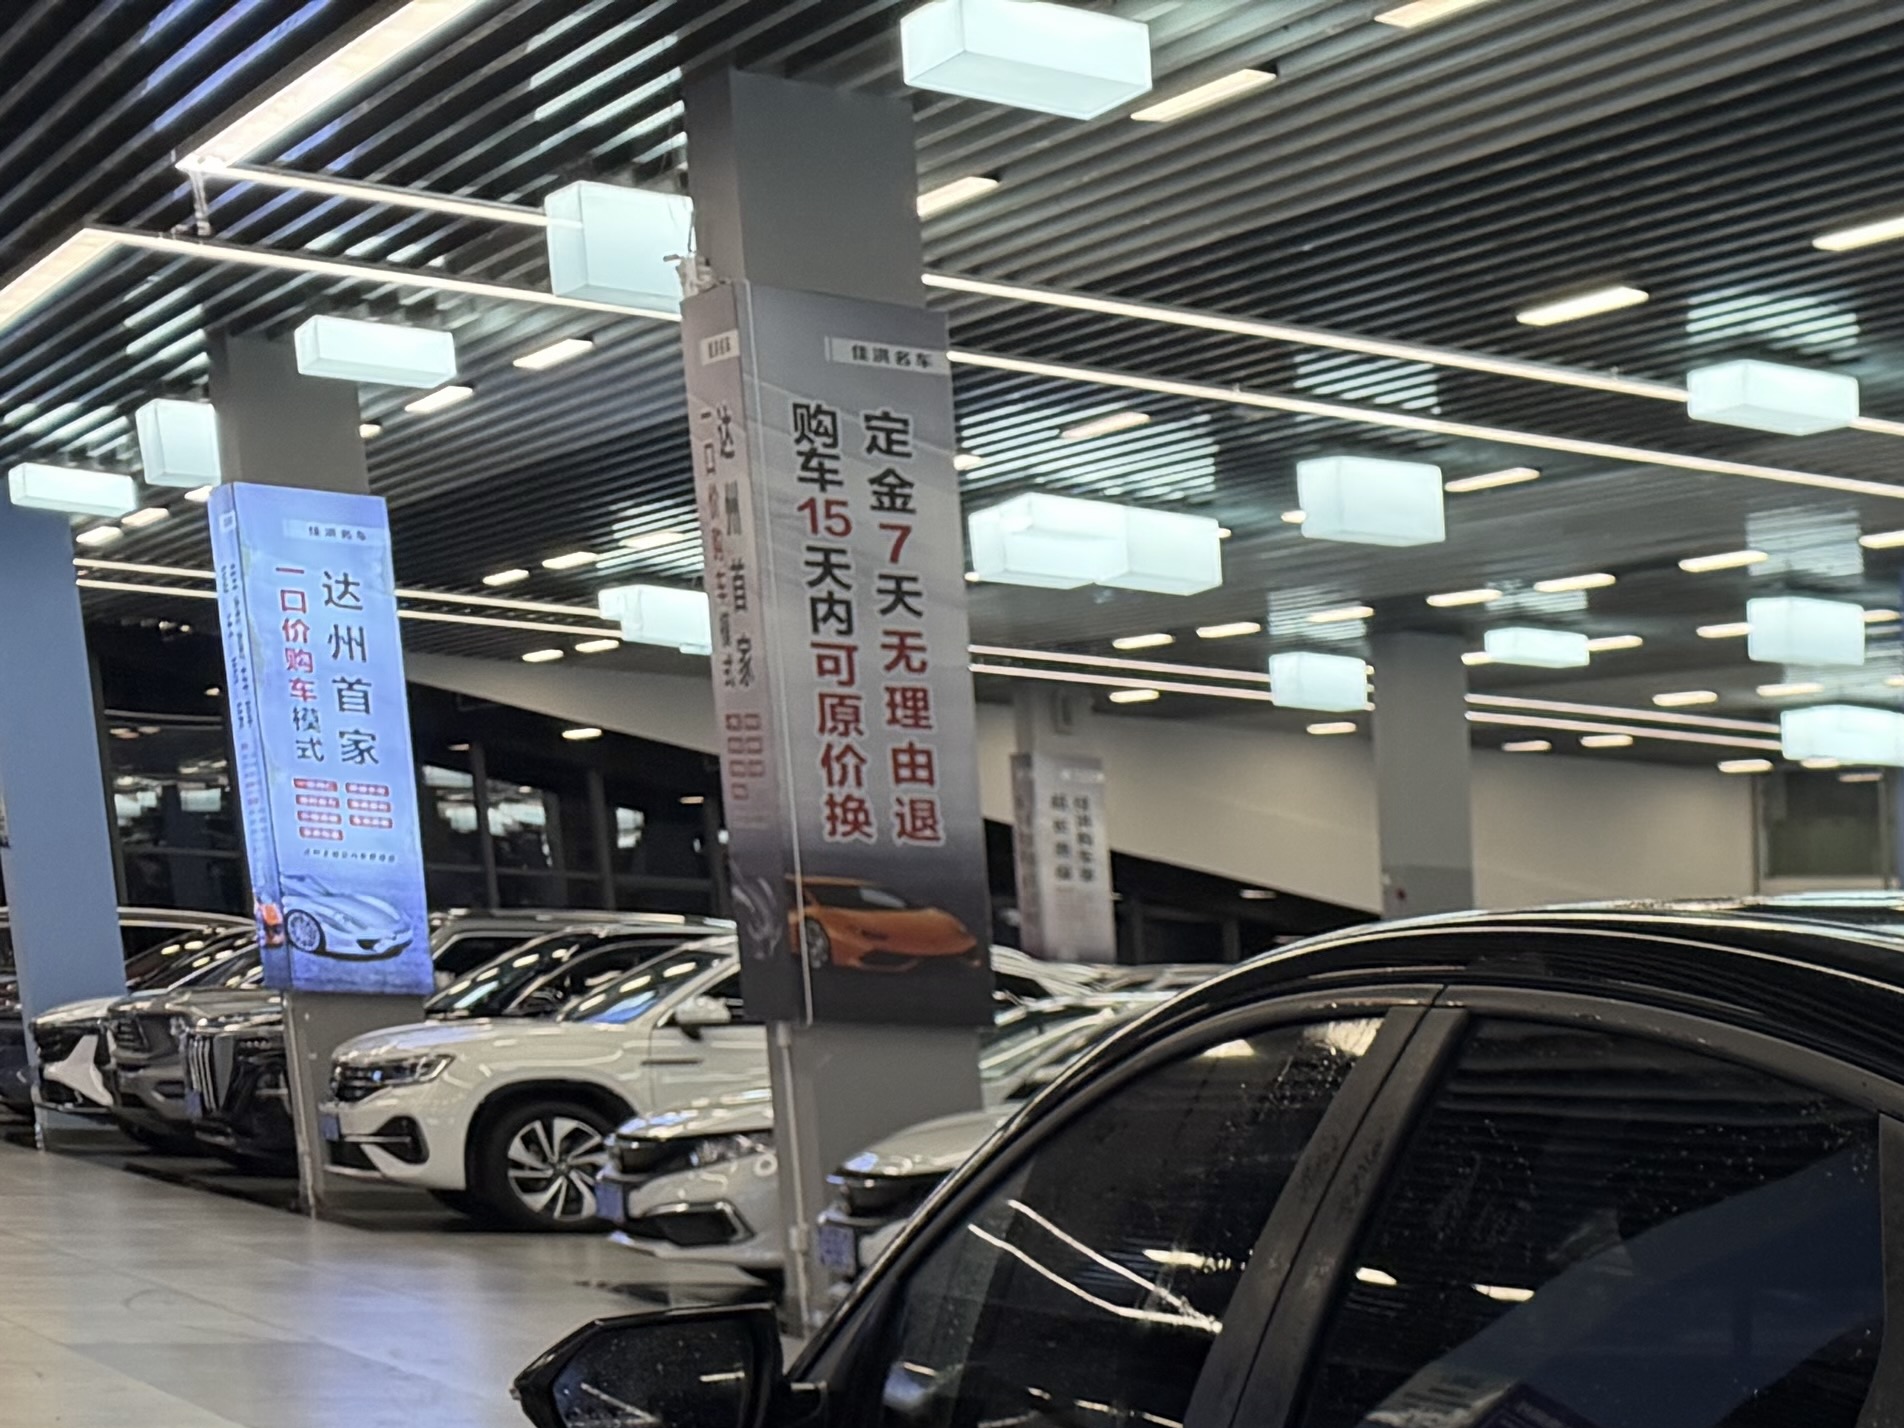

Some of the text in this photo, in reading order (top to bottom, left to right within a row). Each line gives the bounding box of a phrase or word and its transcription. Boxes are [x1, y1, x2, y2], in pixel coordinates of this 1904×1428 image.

[275, 566, 324, 762] 一口价购车模式
[321, 571, 379, 765] 达州首家
[792, 402, 874, 839] 购车15天内可原价换
[863, 411, 941, 841] 定金7天无理由退
